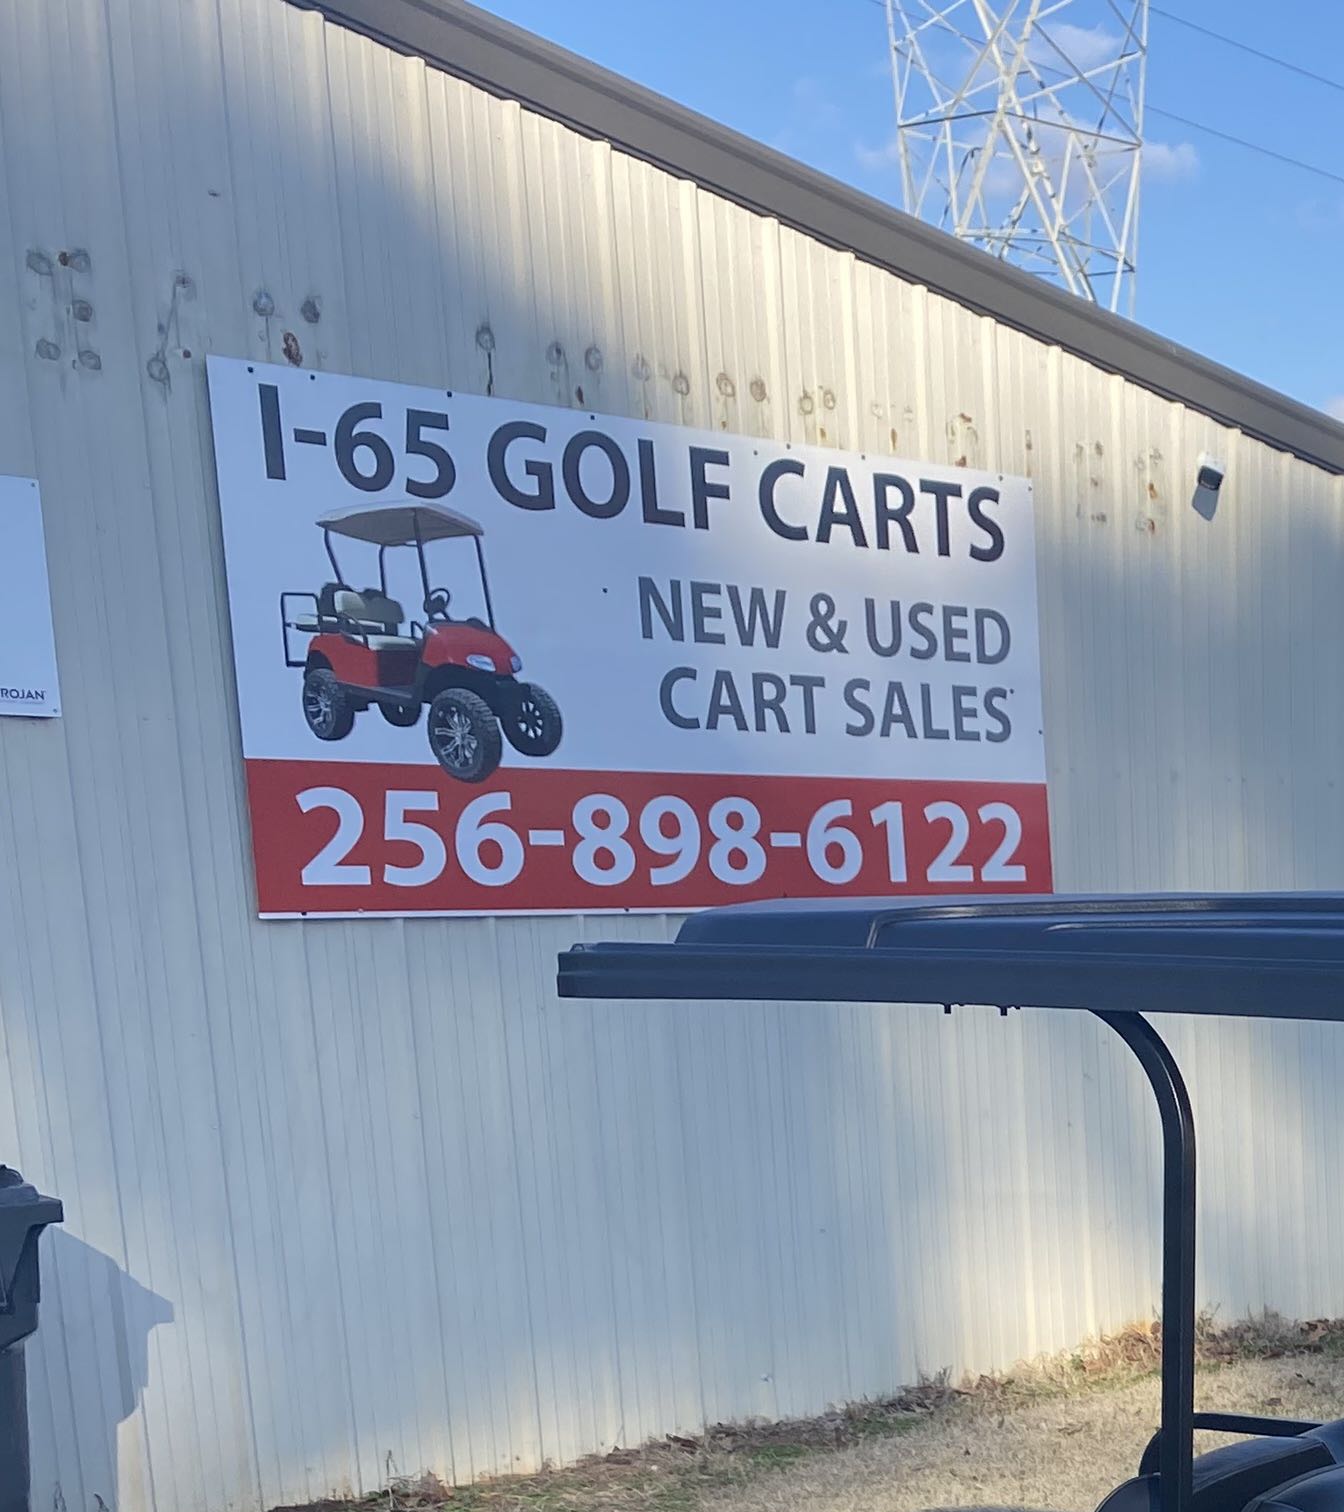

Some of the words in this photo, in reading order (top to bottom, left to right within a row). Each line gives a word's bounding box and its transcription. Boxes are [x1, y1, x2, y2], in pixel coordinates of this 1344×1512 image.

[258, 383, 456, 499] I-65
[487, 420, 731, 530] GOLF
[759, 458, 1004, 562] CARTS
[638, 576, 787, 649] NEW
[806, 592, 849, 655] &
[864, 598, 1011, 665] USED
[659, 666, 826, 734] CART
[843, 678, 1012, 743] SALES
[295, 787, 1027, 887] 256-898-6122
